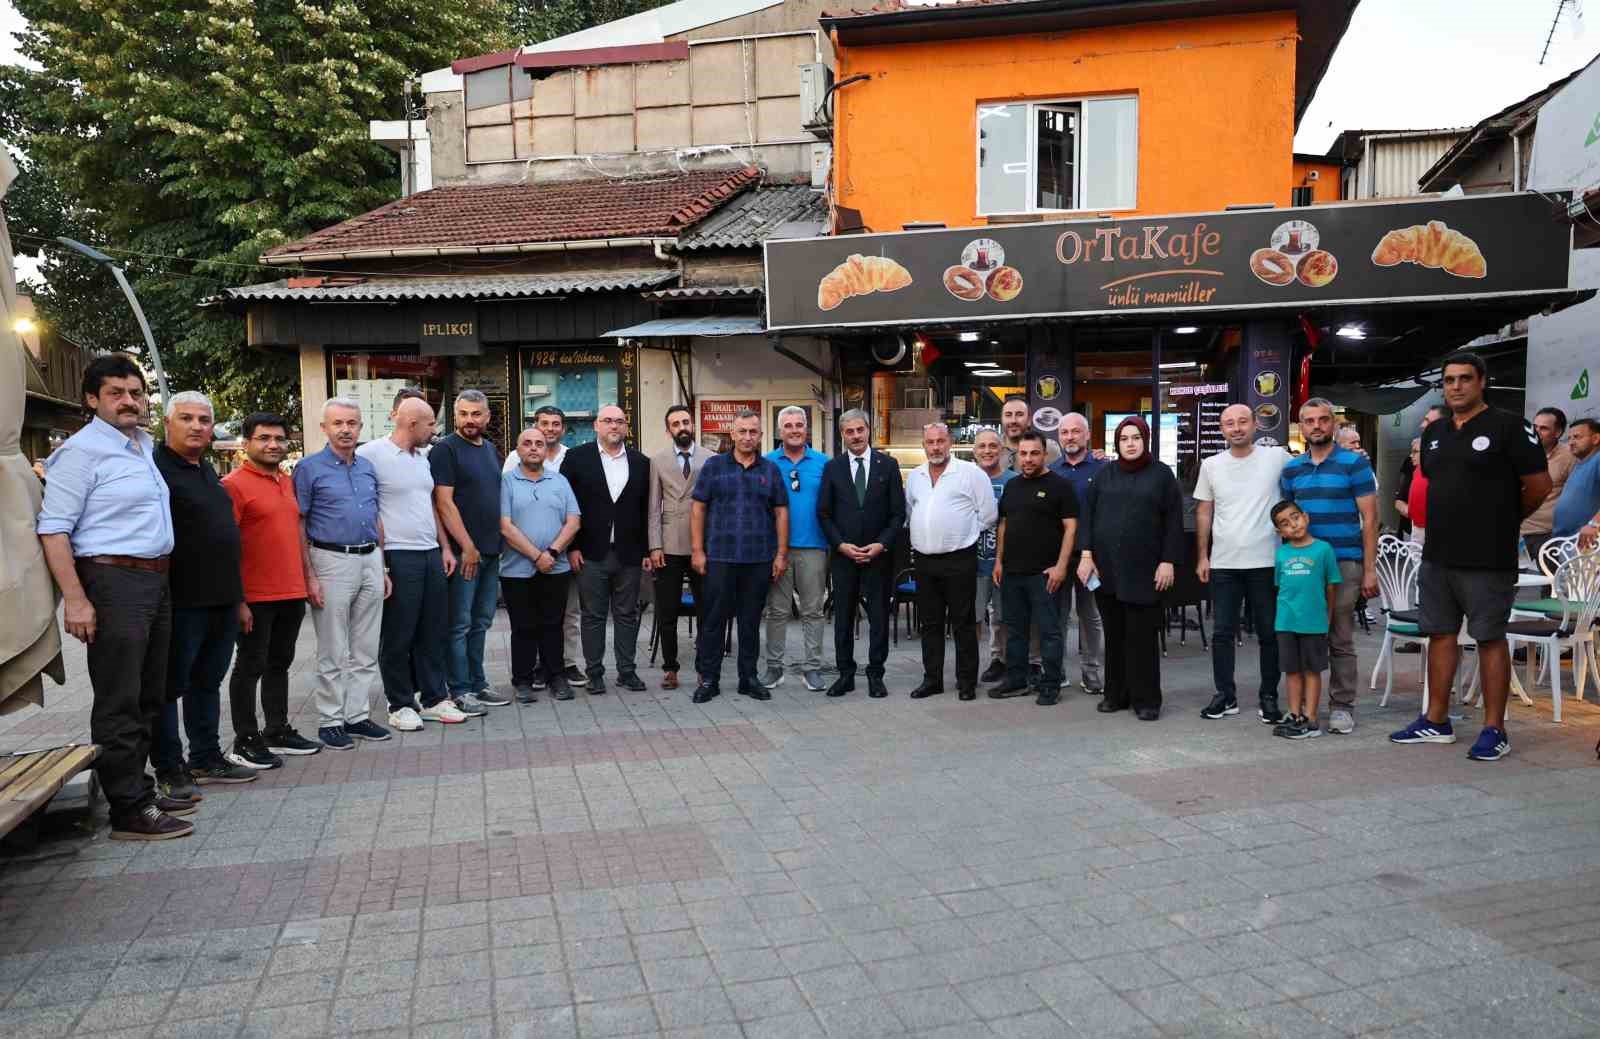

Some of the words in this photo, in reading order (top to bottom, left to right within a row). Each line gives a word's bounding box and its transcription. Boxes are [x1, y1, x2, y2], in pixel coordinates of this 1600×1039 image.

[1056, 223, 1221, 265] OrTaKafe
[1108, 284, 1140, 305] ünlü
[1144, 281, 1217, 304] mamüller
